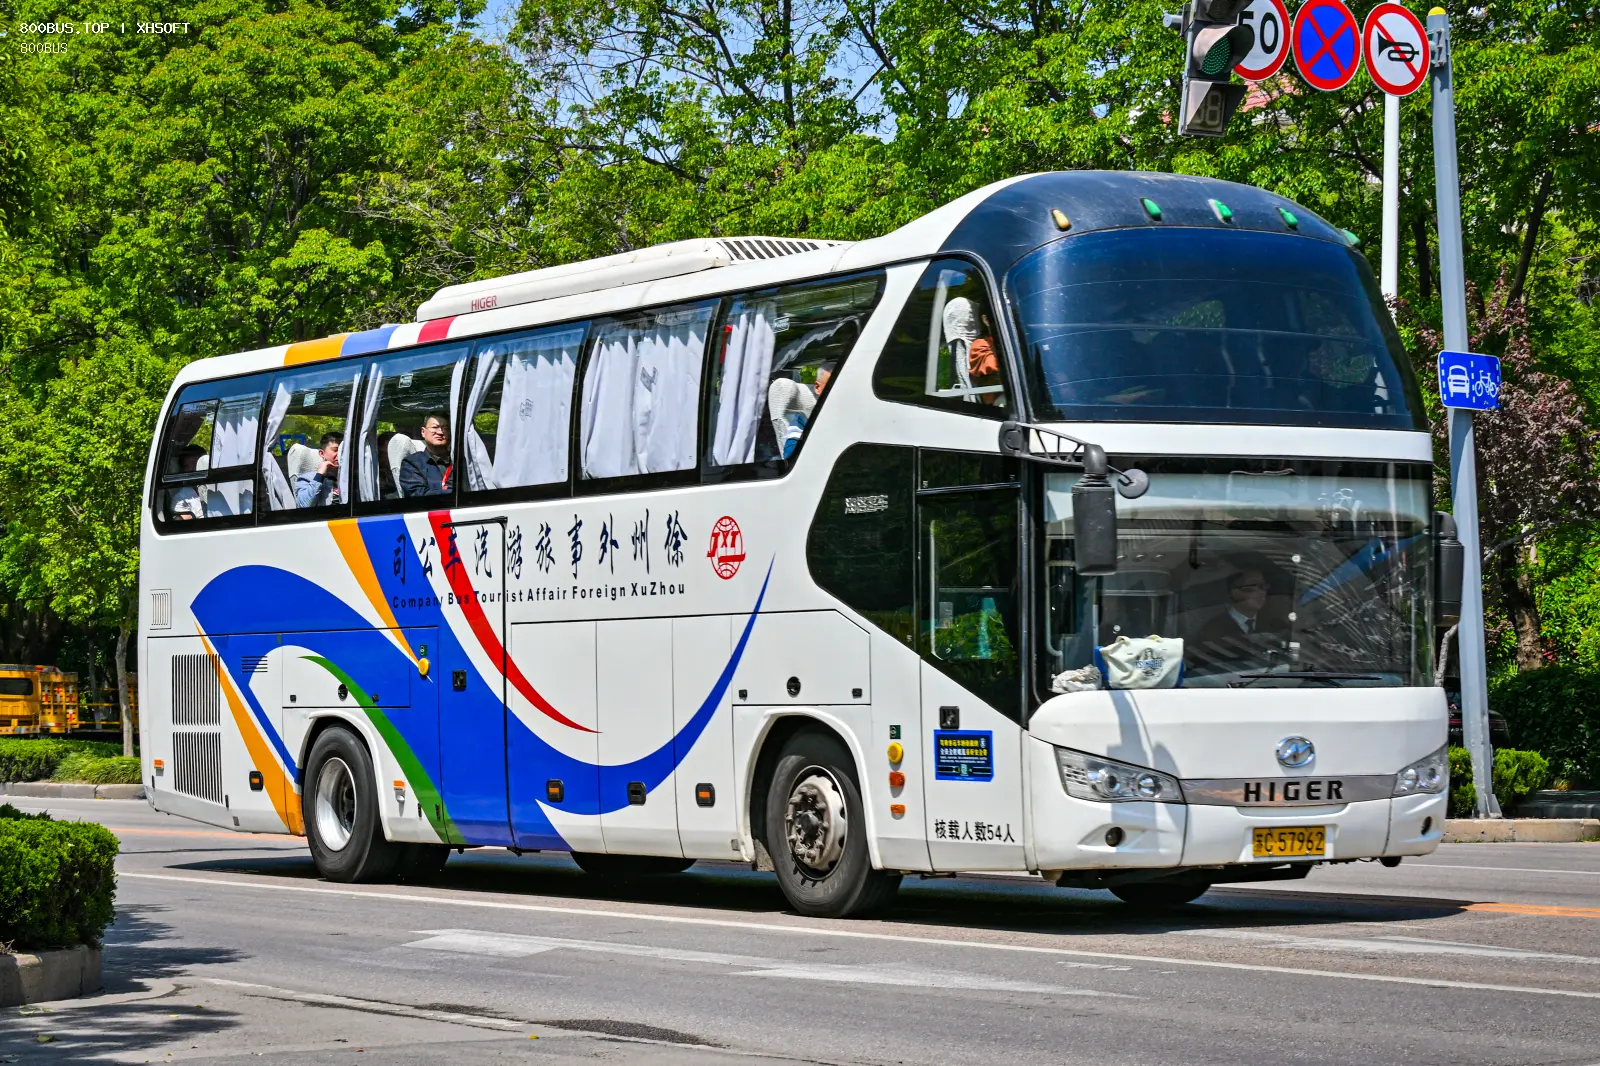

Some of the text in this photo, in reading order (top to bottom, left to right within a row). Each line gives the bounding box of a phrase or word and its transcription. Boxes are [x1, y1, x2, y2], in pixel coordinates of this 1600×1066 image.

[471, 295, 498, 311] HIGER
[447, 591, 470, 605] Bus
[473, 588, 524, 604] Tourist
[526, 586, 568, 602] Affair
[572, 584, 626, 601] Foreign
[630, 581, 685, 597] XuZhou
[1243, 779, 1344, 803] HIGER
[934, 818, 1016, 844] 核载人数54人
